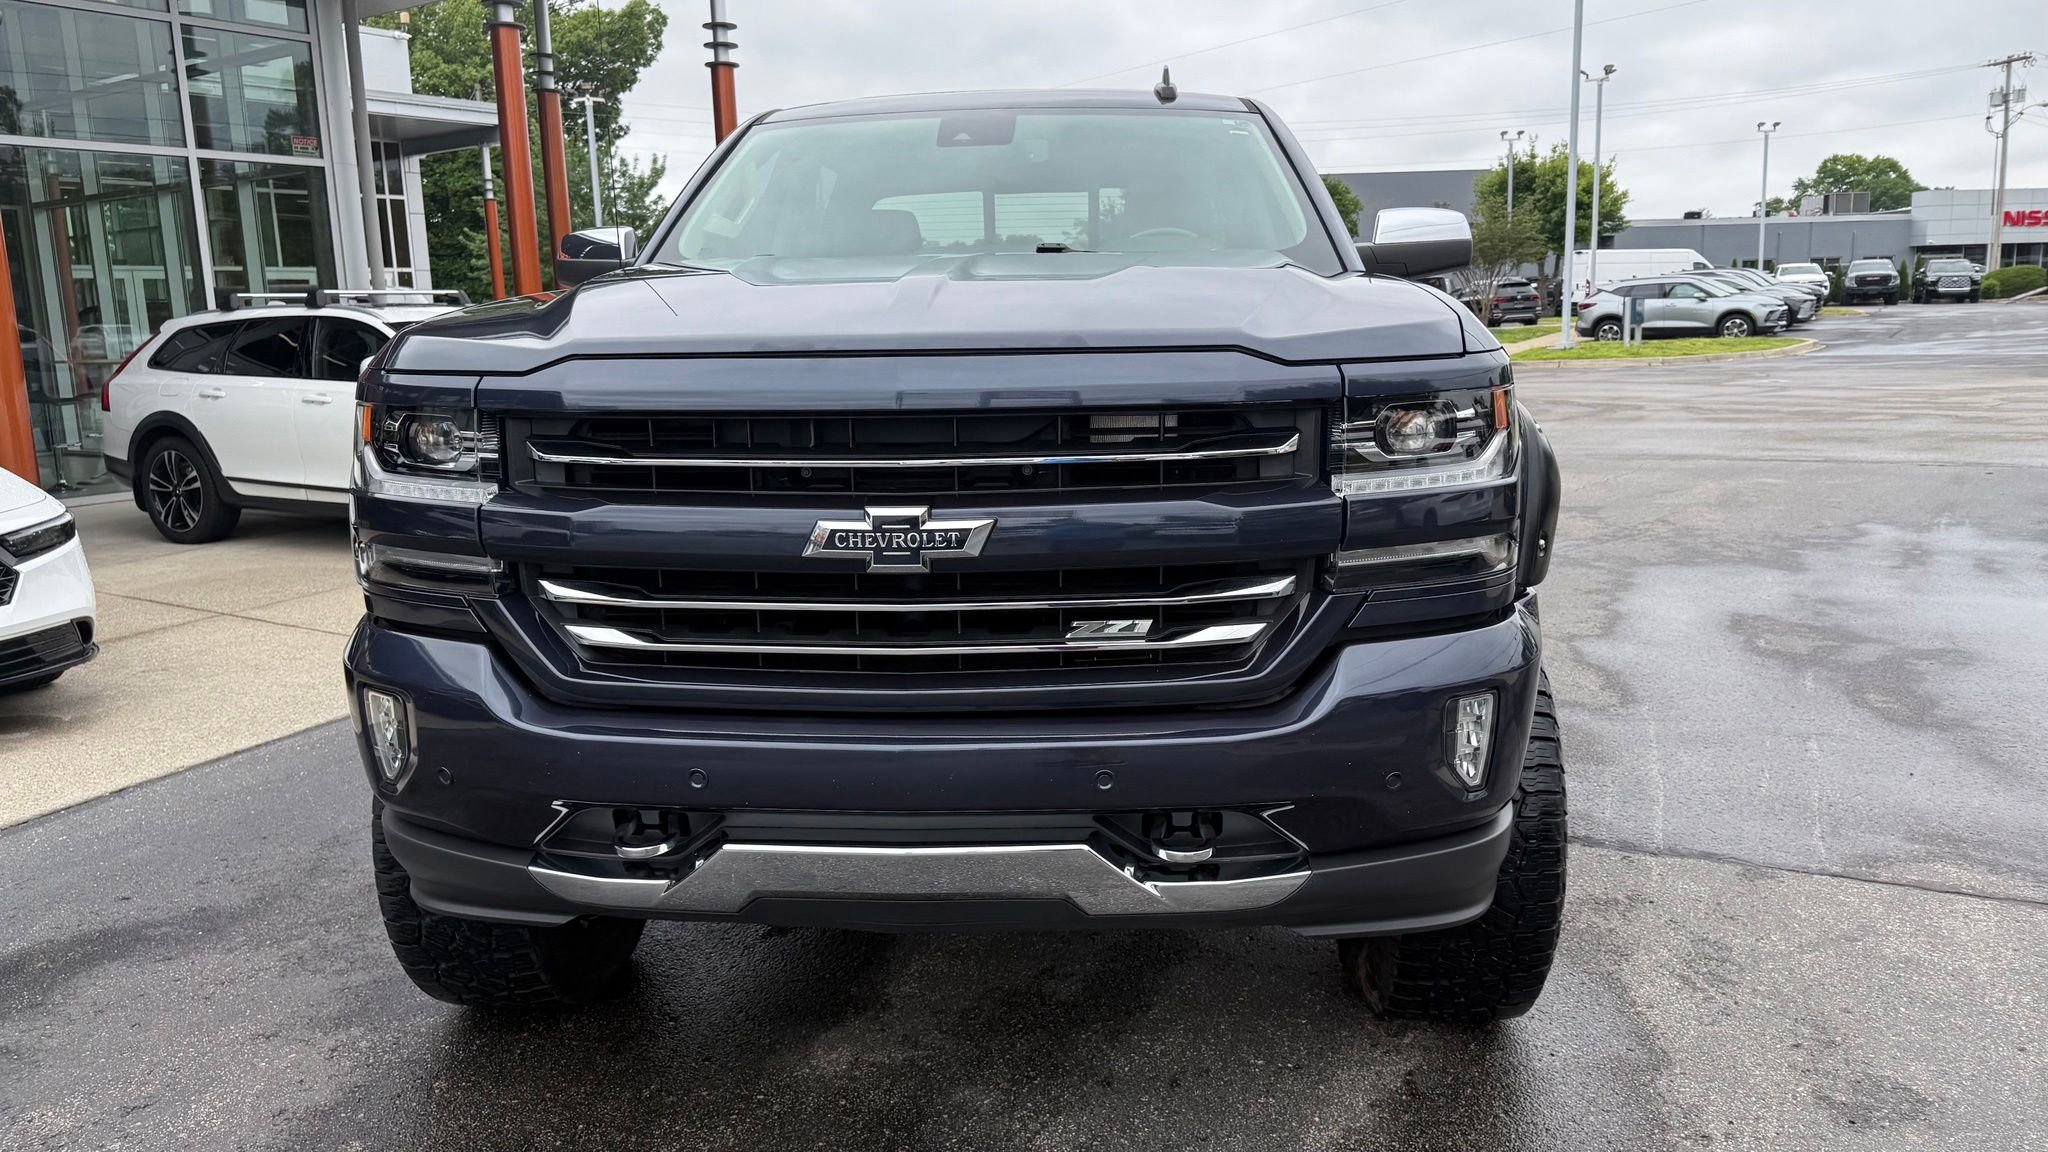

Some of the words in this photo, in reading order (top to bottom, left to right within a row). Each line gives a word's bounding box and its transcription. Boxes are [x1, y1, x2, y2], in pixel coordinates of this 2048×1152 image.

[293, 137, 318, 146] NOTICE
[834, 532, 960, 548] CHEVROLET
[1065, 619, 1153, 638] Z71
